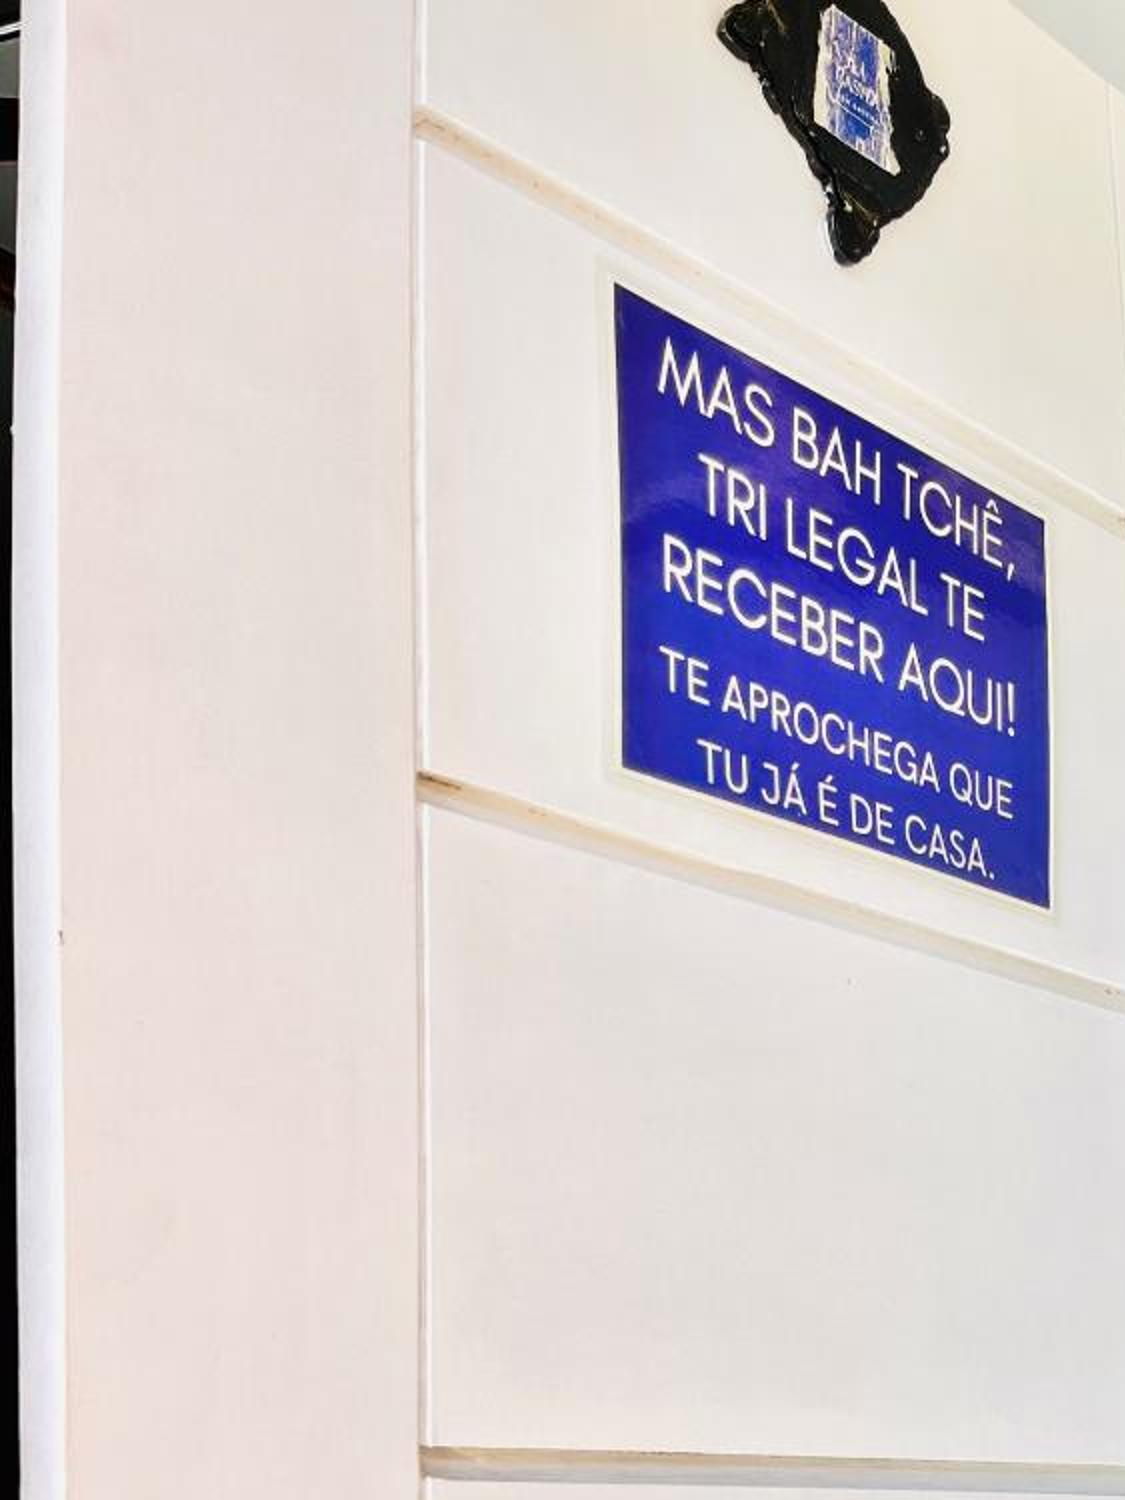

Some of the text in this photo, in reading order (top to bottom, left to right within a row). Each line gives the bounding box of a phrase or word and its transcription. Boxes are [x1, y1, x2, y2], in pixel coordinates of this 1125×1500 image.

[658, 338, 1014, 580] MAS BAH TCHÊ,
[699, 454, 984, 640] TRI LEGAL TE
[664, 533, 1014, 736] RECEBER AQUI!
[660, 646, 1012, 818] TE APROCHEGA QUE
[697, 739, 994, 879] TU JÁ É DE CASA.
